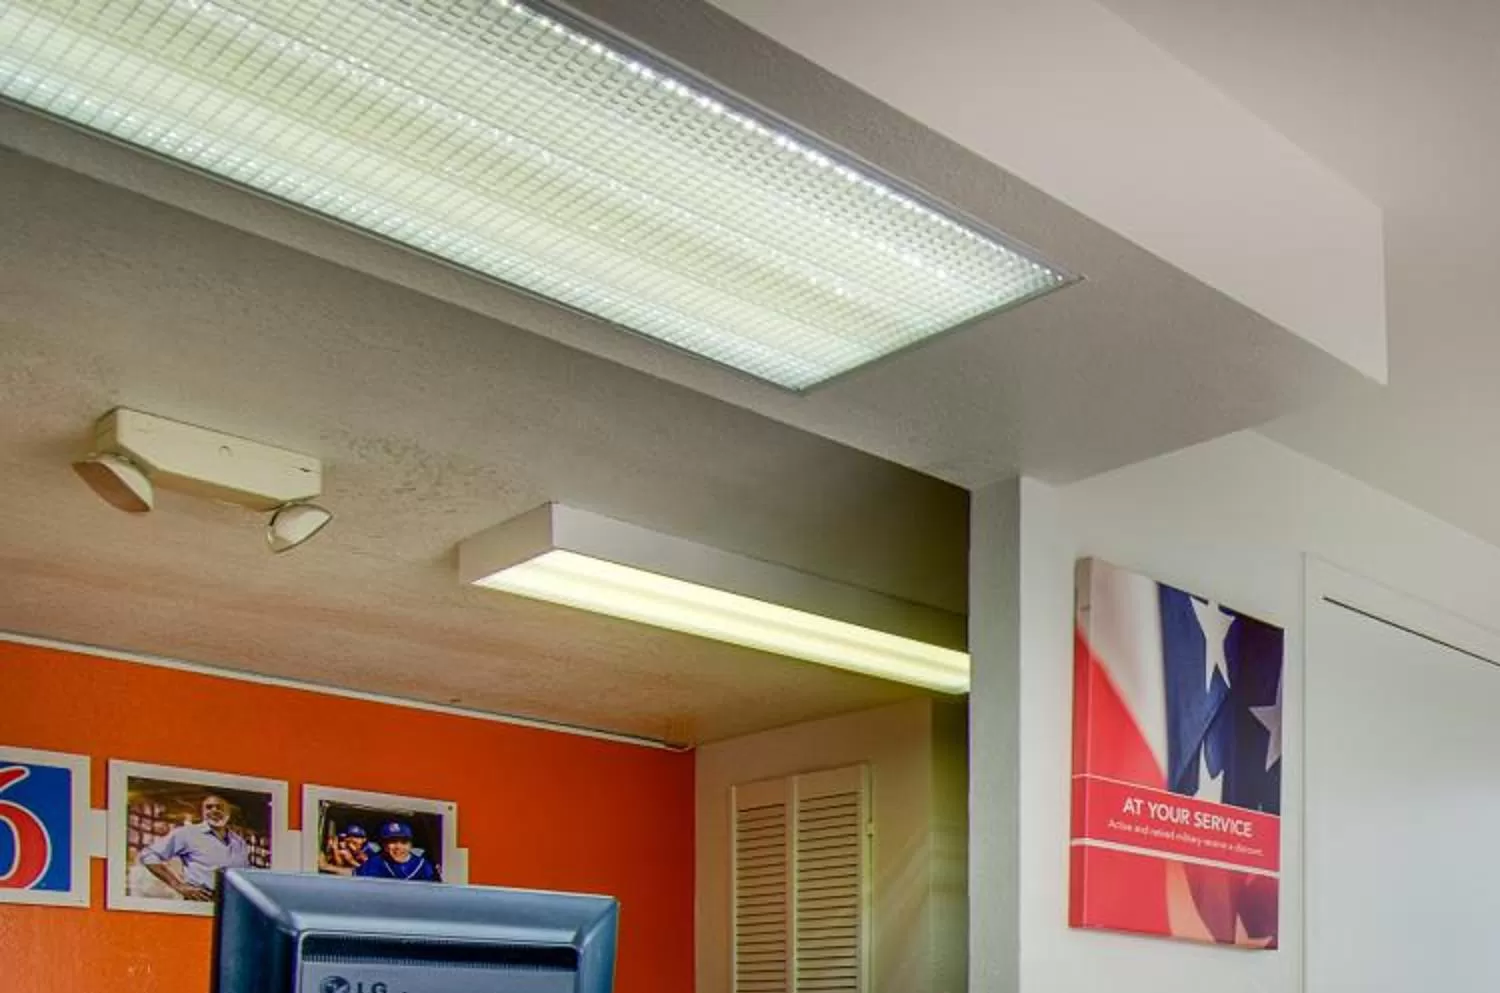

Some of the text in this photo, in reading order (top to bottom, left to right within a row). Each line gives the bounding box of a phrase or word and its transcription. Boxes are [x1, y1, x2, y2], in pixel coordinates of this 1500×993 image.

[1123, 797, 1253, 838] AT YOUR SERVICE
